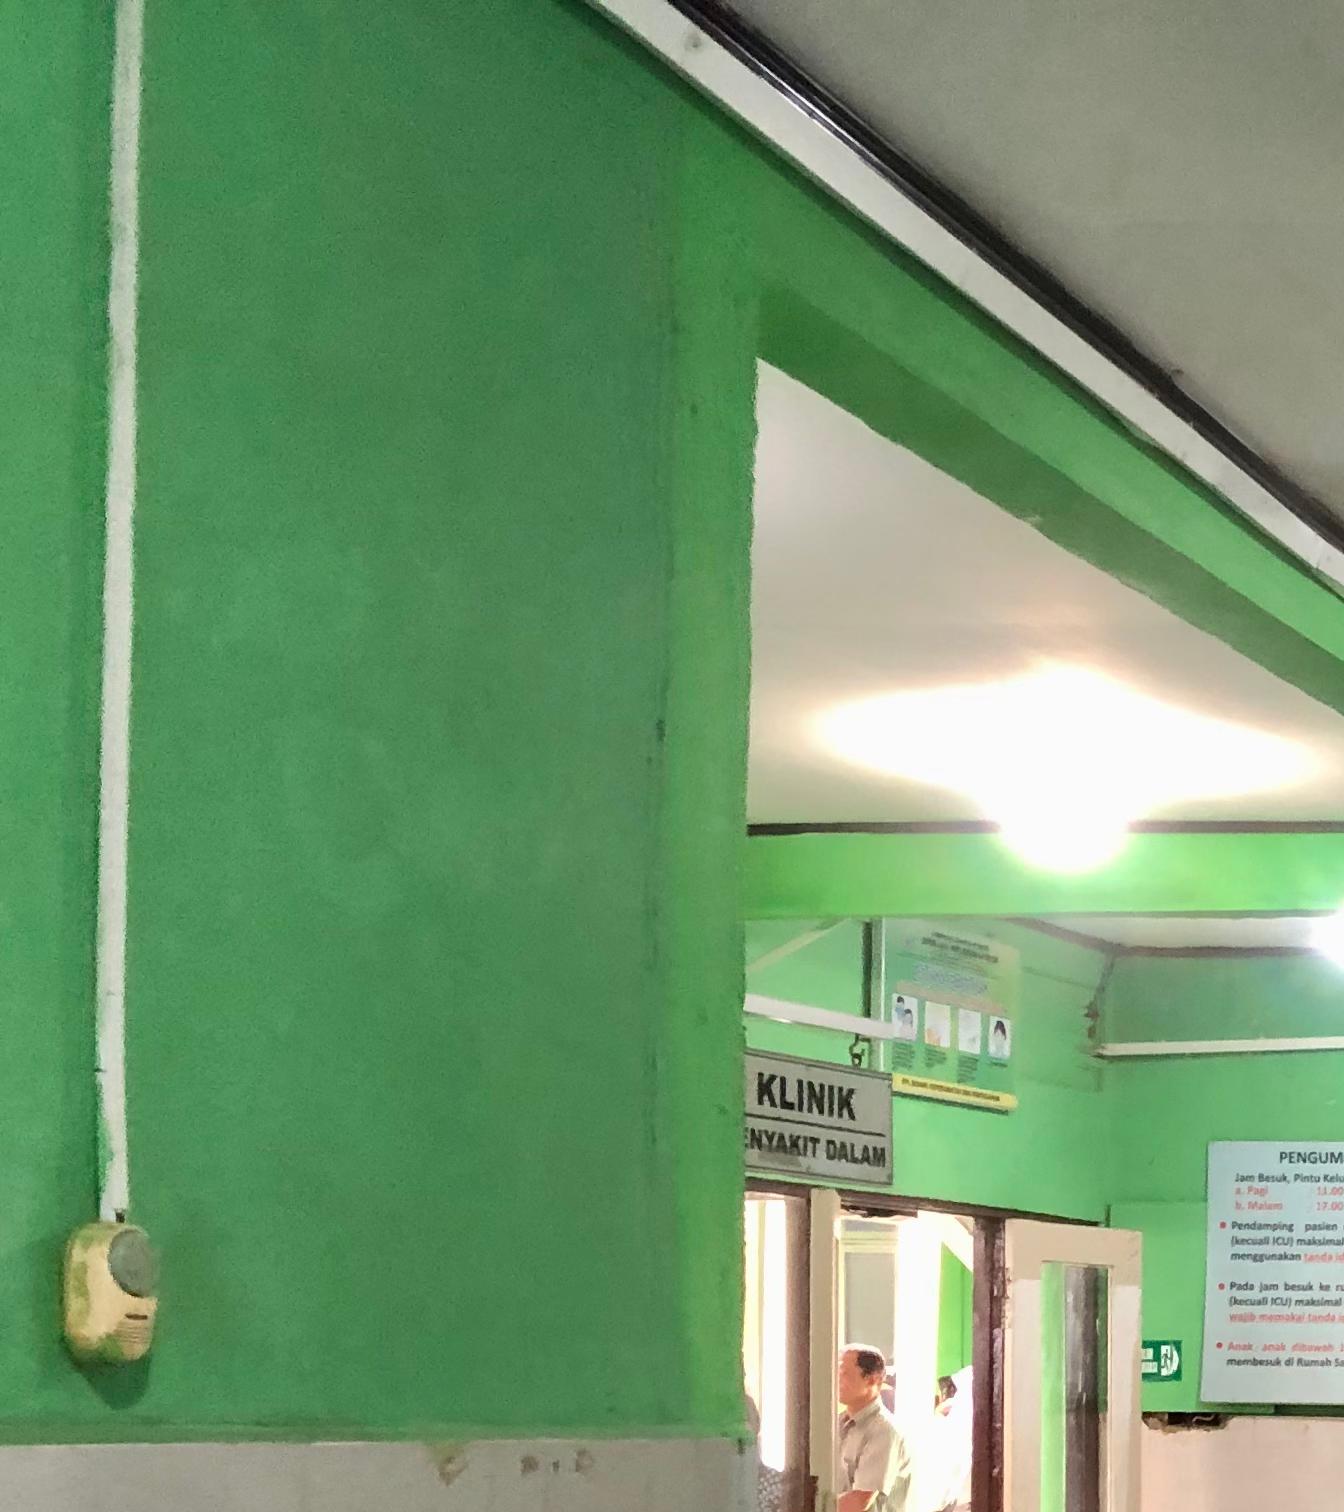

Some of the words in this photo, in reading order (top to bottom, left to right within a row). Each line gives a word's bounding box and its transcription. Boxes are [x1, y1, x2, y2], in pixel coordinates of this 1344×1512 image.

[757, 1072, 856, 1121] KLINIK
[826, 1139, 886, 1168] DALAM
[1235, 1174, 1255, 1183] Jam
[1258, 1173, 1290, 1184] Besuk,
[1294, 1174, 1321, 1183] Pintu
[1231, 1222, 1294, 1232] Pendamping
[1304, 1223, 1338, 1232] pasien
[1297, 1237, 1344, 1246] maksimal
[1231, 1252, 1301, 1263] menggunakan
[1230, 1282, 1254, 1291] Pada
[1260, 1283, 1278, 1293] jam
[1284, 1283, 1313, 1291] besuk
[1319, 1283, 1330, 1291] ke
[1295, 1298, 1342, 1306] maksimal
[1228, 1343, 1253, 1352] Anak
[1227, 1358, 1281, 1366] membesuk
[1285, 1358, 1294, 1366] di
[1297, 1358, 1331, 1366] Rumah
